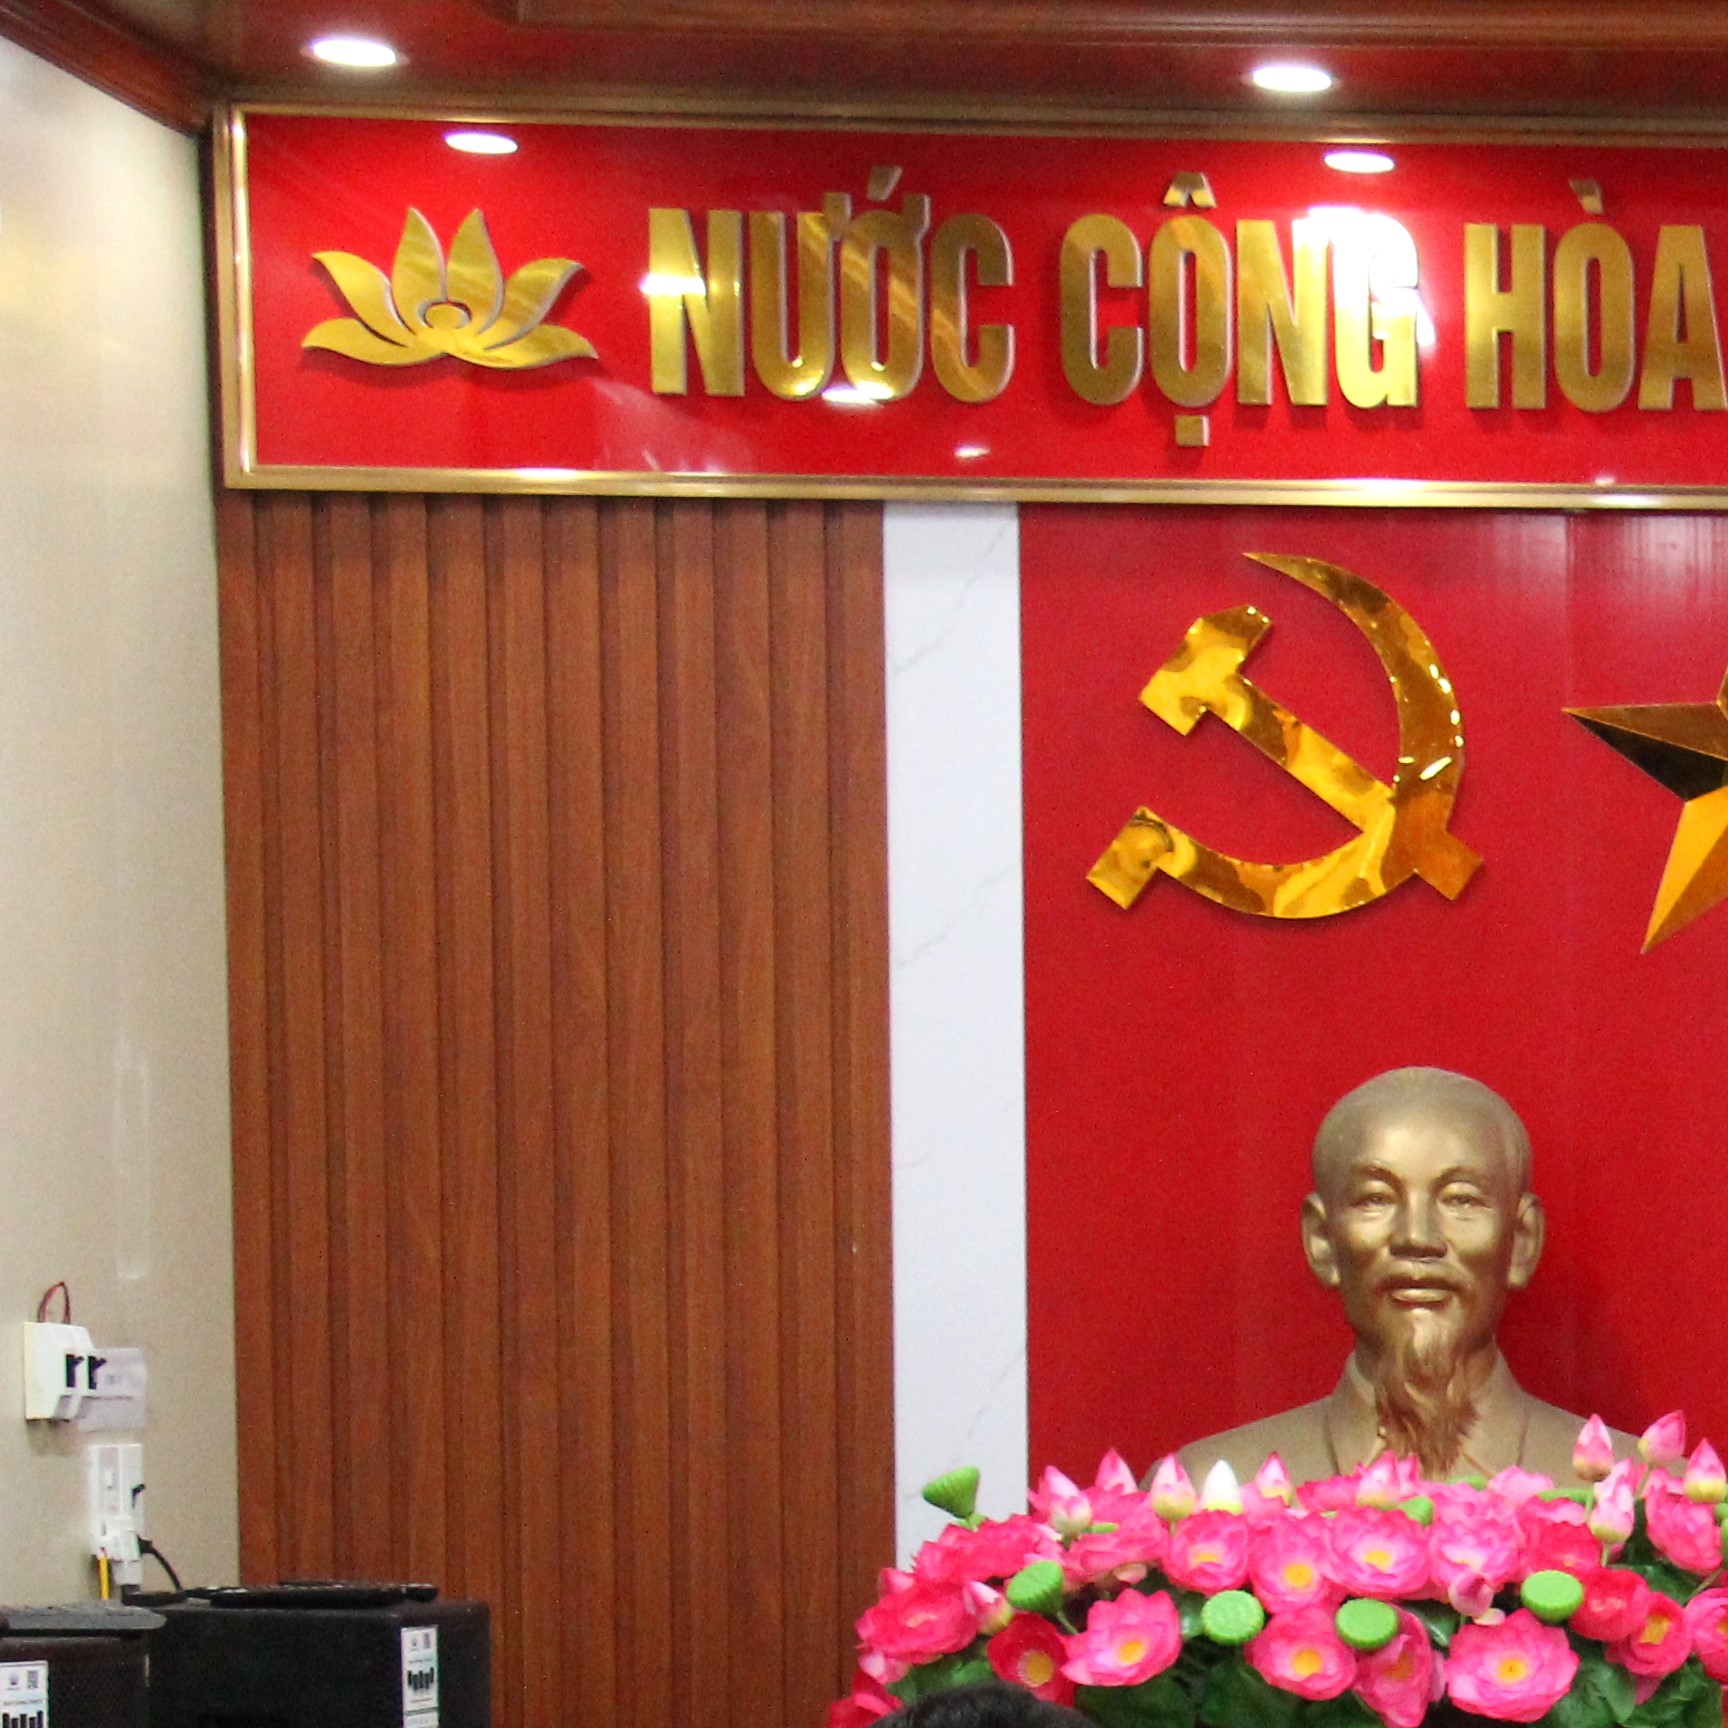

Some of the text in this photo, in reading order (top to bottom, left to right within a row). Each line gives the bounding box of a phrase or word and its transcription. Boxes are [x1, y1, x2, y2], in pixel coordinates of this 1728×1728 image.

[648, 166, 1015, 403] NƯỚC
[1060, 171, 1420, 447] CỘNG
[1463, 178, 1728, 414] HÒA
